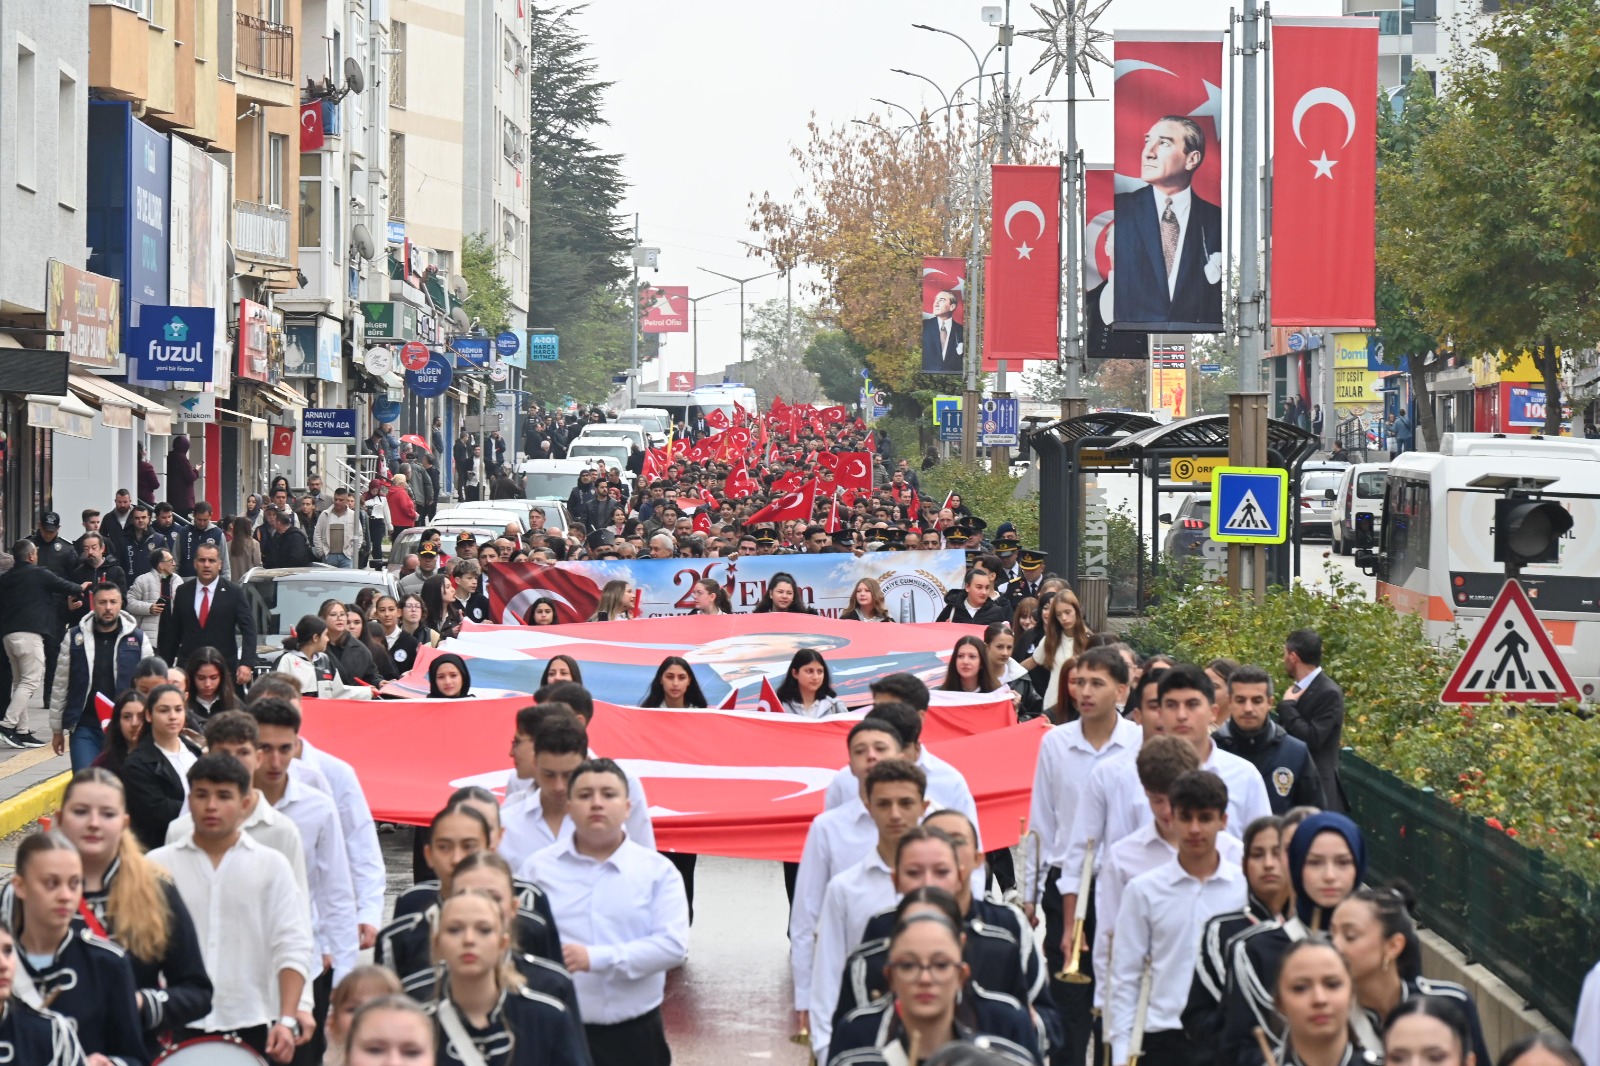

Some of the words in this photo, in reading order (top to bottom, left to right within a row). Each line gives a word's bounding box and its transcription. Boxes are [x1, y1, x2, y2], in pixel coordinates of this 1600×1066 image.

[148, 340, 203, 362] fuzul
[1180, 464, 1189, 475] 9
[900, 578, 939, 599] CUMHURİYETİ
